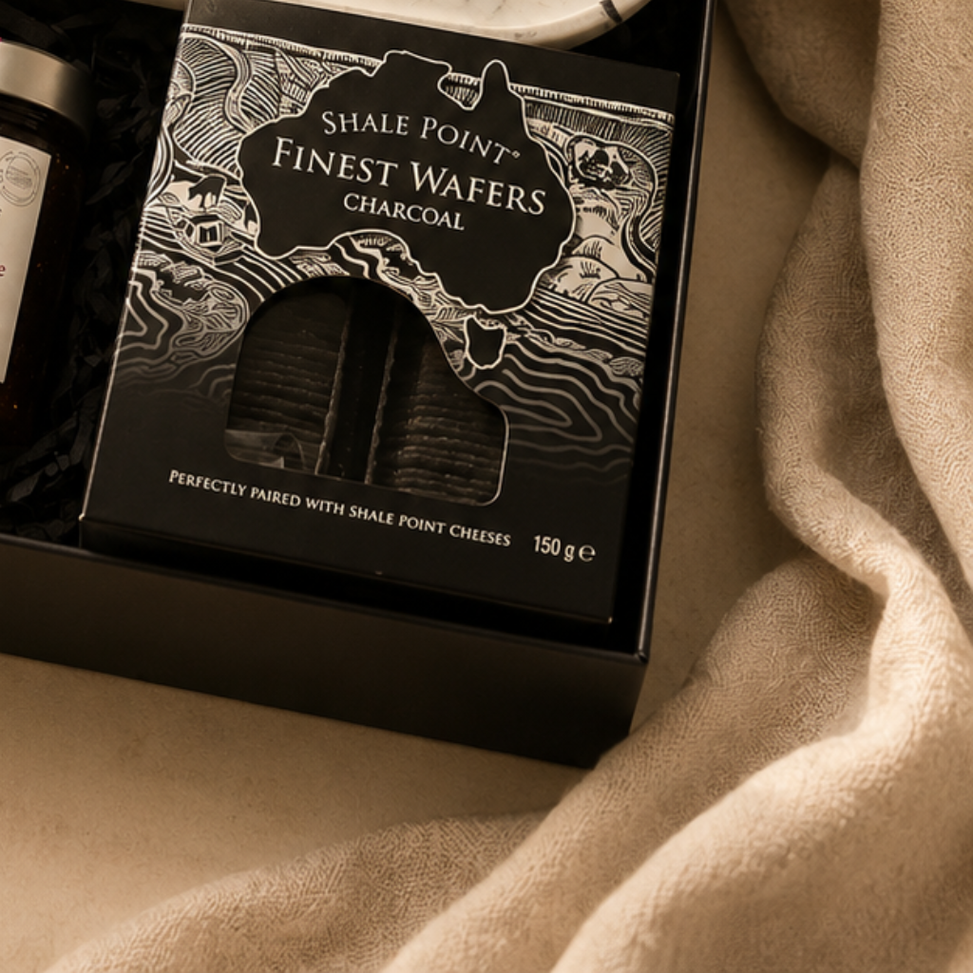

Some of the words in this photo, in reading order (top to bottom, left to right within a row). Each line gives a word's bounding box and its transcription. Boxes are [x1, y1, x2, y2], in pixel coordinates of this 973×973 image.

[321, 111, 410, 136] SHALE
[272, 136, 399, 188] FINEST
[409, 160, 546, 215] WAFERS
[343, 192, 465, 231] CHARCOAL
[168, 469, 247, 497] PERFECTLY
[250, 486, 301, 508] PAIRED
[305, 496, 345, 516] WITH
[348, 505, 394, 525] SHALE
[398, 514, 447, 535] POINT
[449, 524, 512, 548] CHEESES
